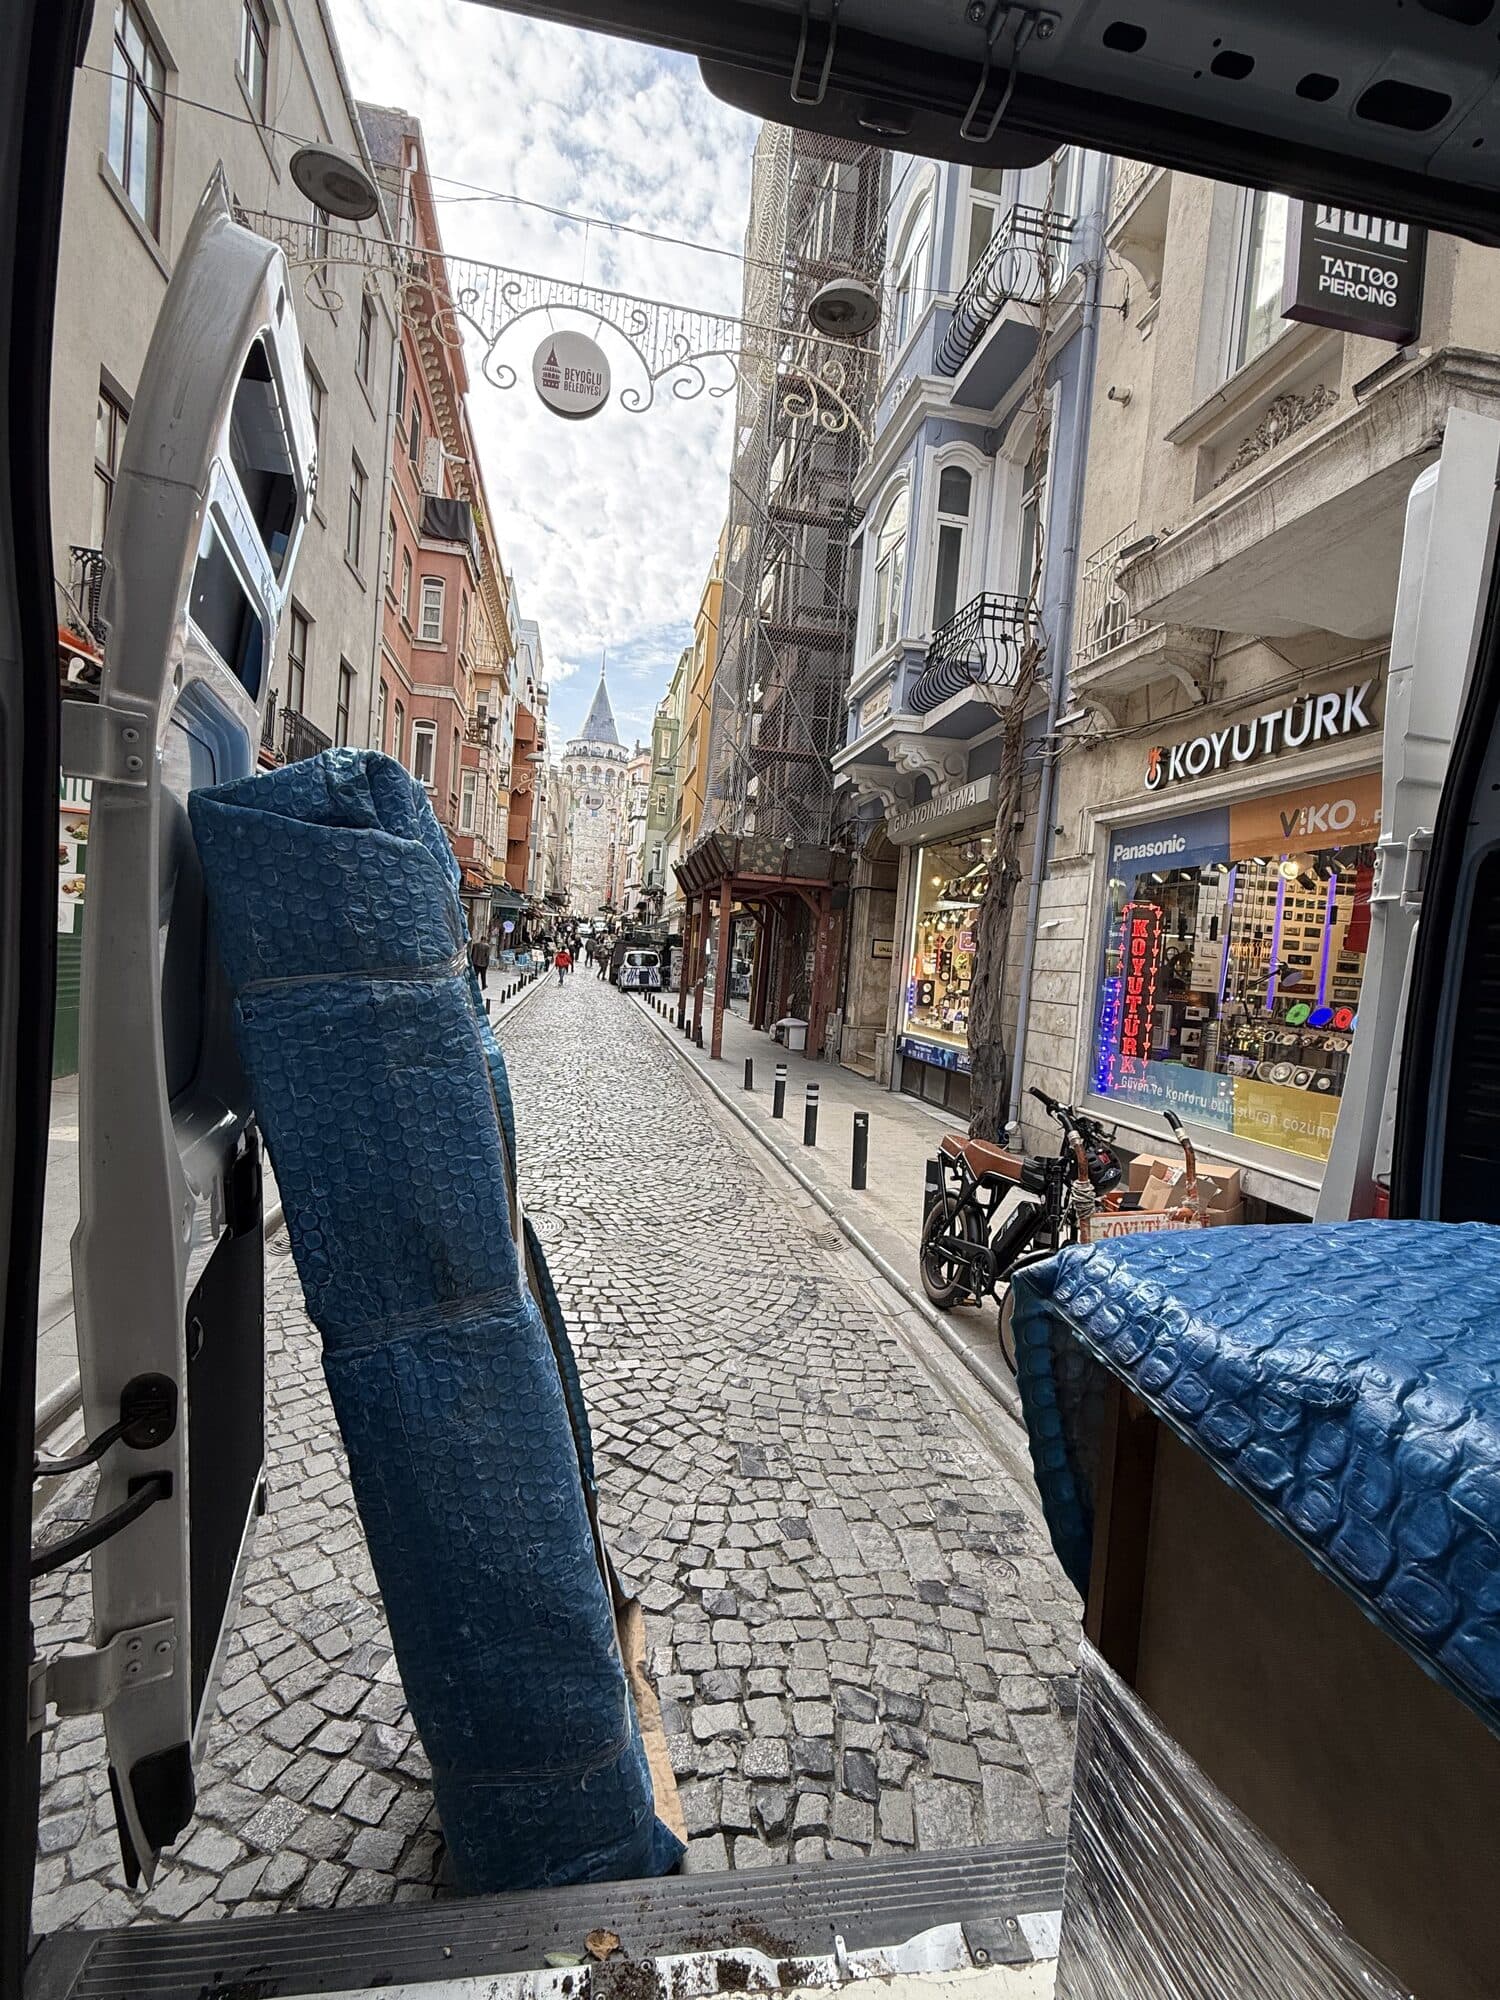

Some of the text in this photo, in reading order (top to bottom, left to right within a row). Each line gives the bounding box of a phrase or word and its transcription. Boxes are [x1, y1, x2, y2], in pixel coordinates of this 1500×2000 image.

[1319, 275, 1397, 307] PIERCING
[564, 367, 602, 386] BEYOĞLU
[1168, 679, 1372, 781] KOYUTÜRK
[908, 784, 976, 829] AYDINLATMA
[1113, 834, 1186, 862] Panasonic
[1119, 918, 1150, 1074] KOYUTÜRK
